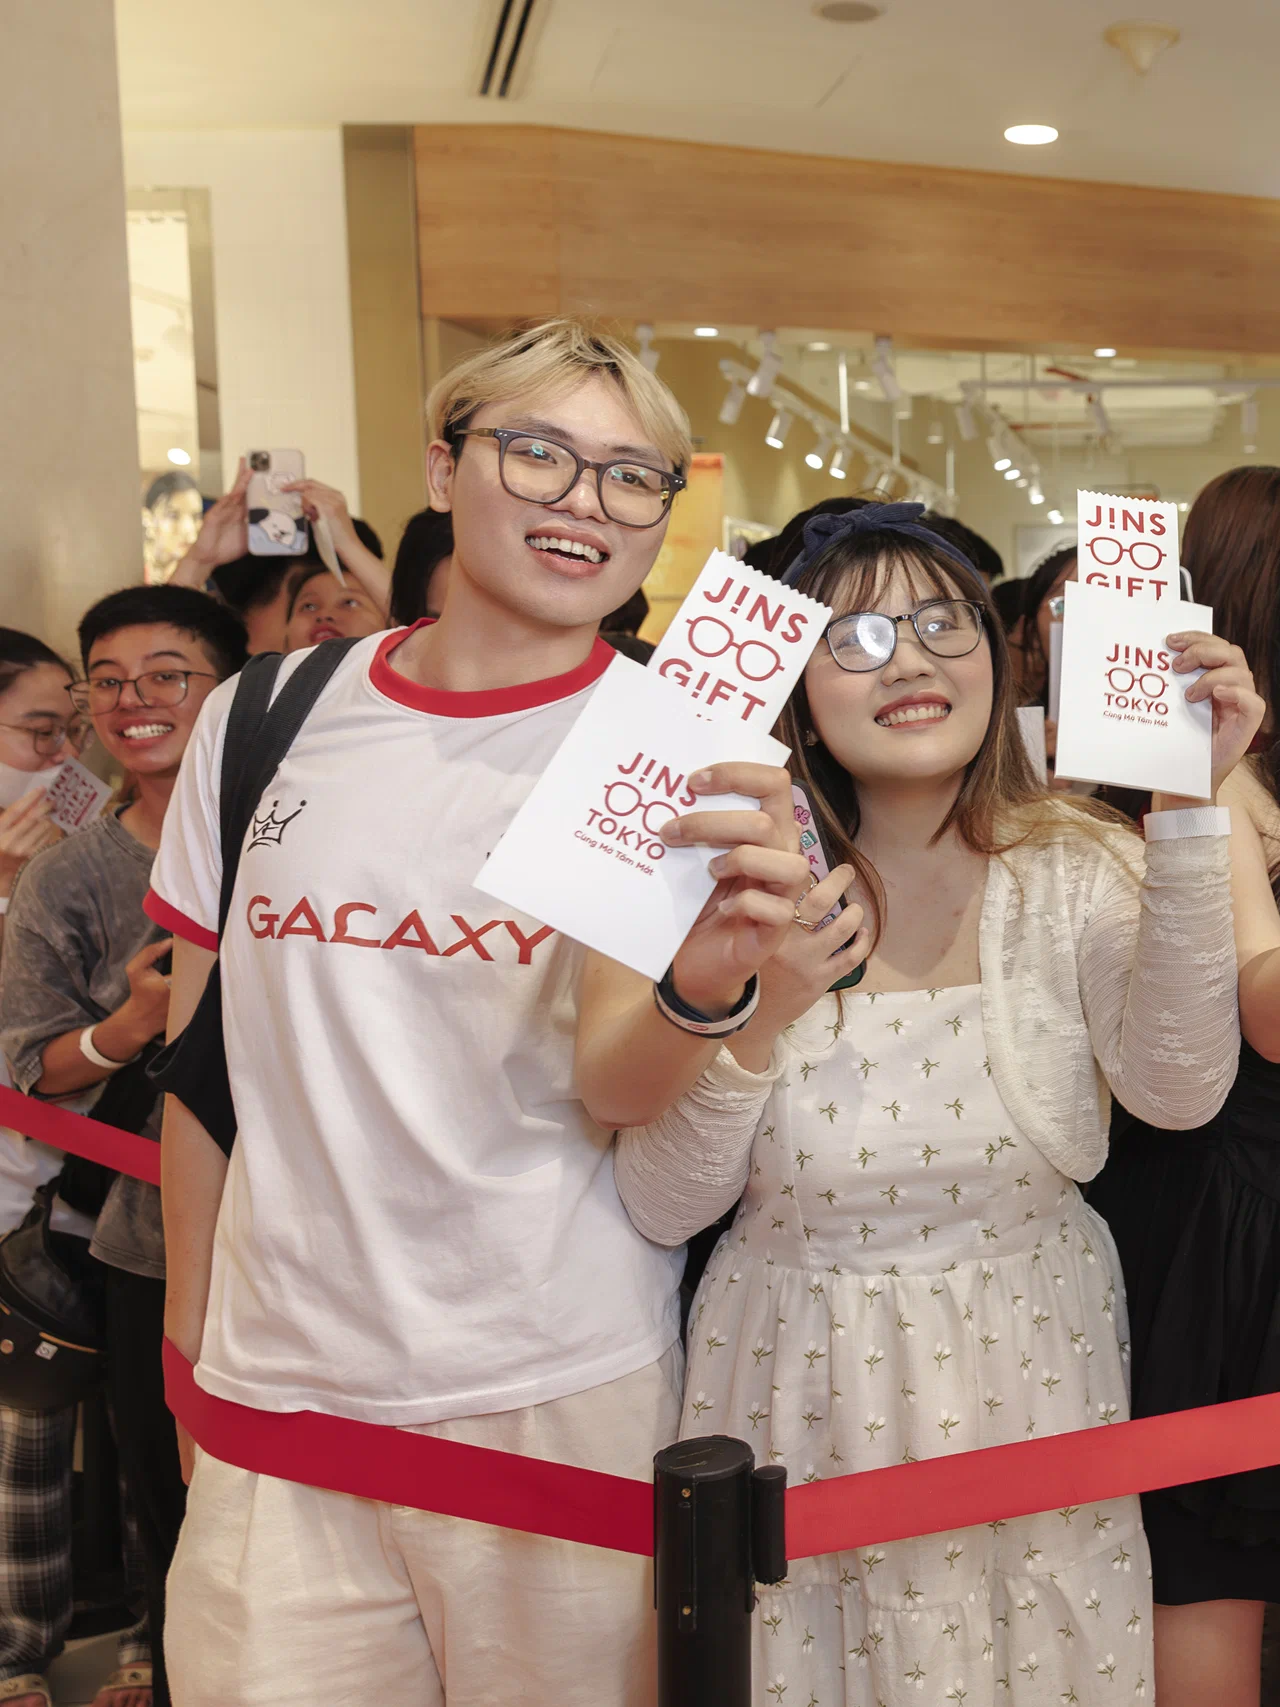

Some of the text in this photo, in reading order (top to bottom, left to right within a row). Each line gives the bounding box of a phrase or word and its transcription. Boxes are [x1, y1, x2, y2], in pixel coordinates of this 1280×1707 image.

[1104, 692, 1169, 715] TOKYO
[587, 808, 665, 860] TOKYO
[247, 895, 556, 965] GALAXY
